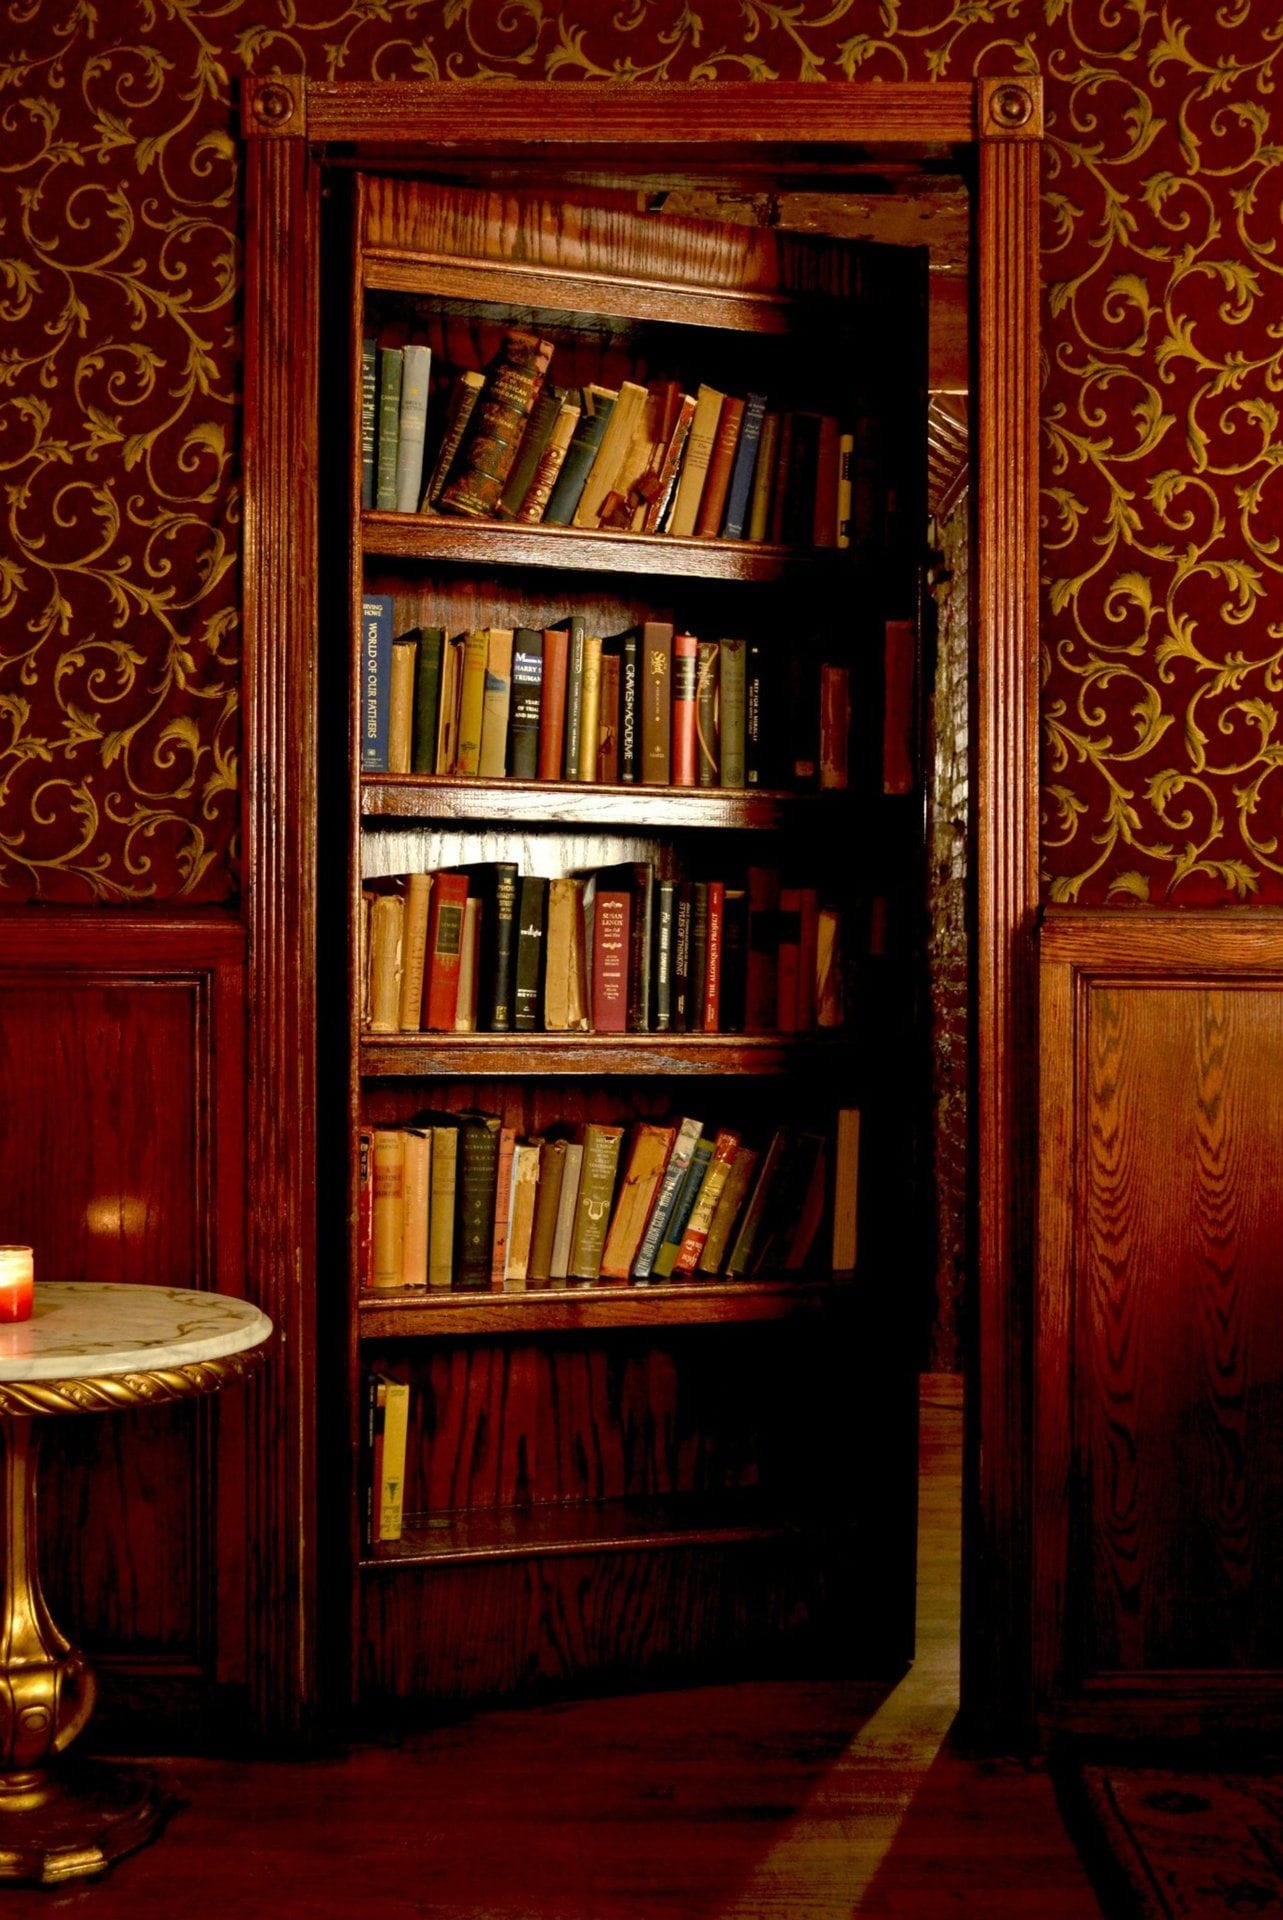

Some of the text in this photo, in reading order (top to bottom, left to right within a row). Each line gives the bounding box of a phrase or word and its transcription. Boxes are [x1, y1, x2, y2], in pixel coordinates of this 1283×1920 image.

[367, 622, 379, 739] WORLD OF OUR FATHERS
[514, 665, 538, 673] HARRY
[625, 664, 636, 703] GRAVES
[624, 708, 635, 760] ACADEME
[675, 901, 686, 976] STYLES OF THINKING
[645, 1227, 661, 1247] LUCK
[651, 1209, 667, 1229] CLUB
